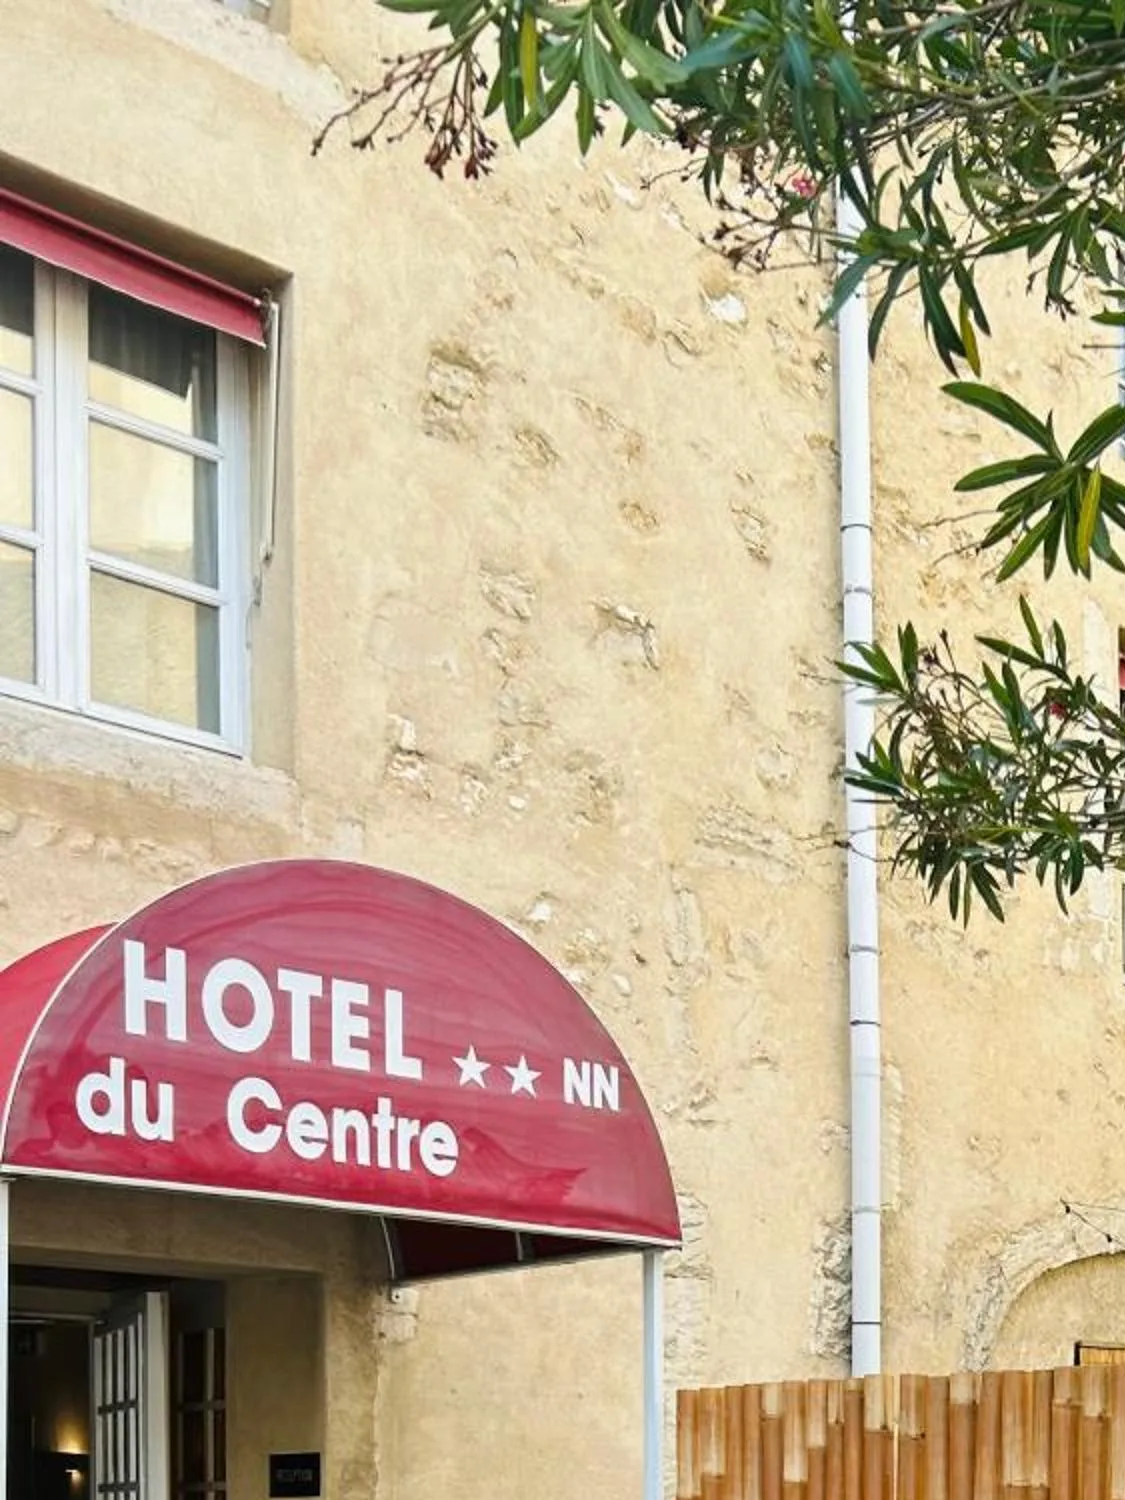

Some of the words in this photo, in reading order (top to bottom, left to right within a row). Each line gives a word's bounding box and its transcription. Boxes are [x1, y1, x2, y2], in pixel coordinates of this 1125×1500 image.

[123, 939, 423, 1079] HOTEL
[562, 1057, 620, 1111] NN
[75, 1057, 174, 1141] du
[227, 1077, 459, 1176] Centre
